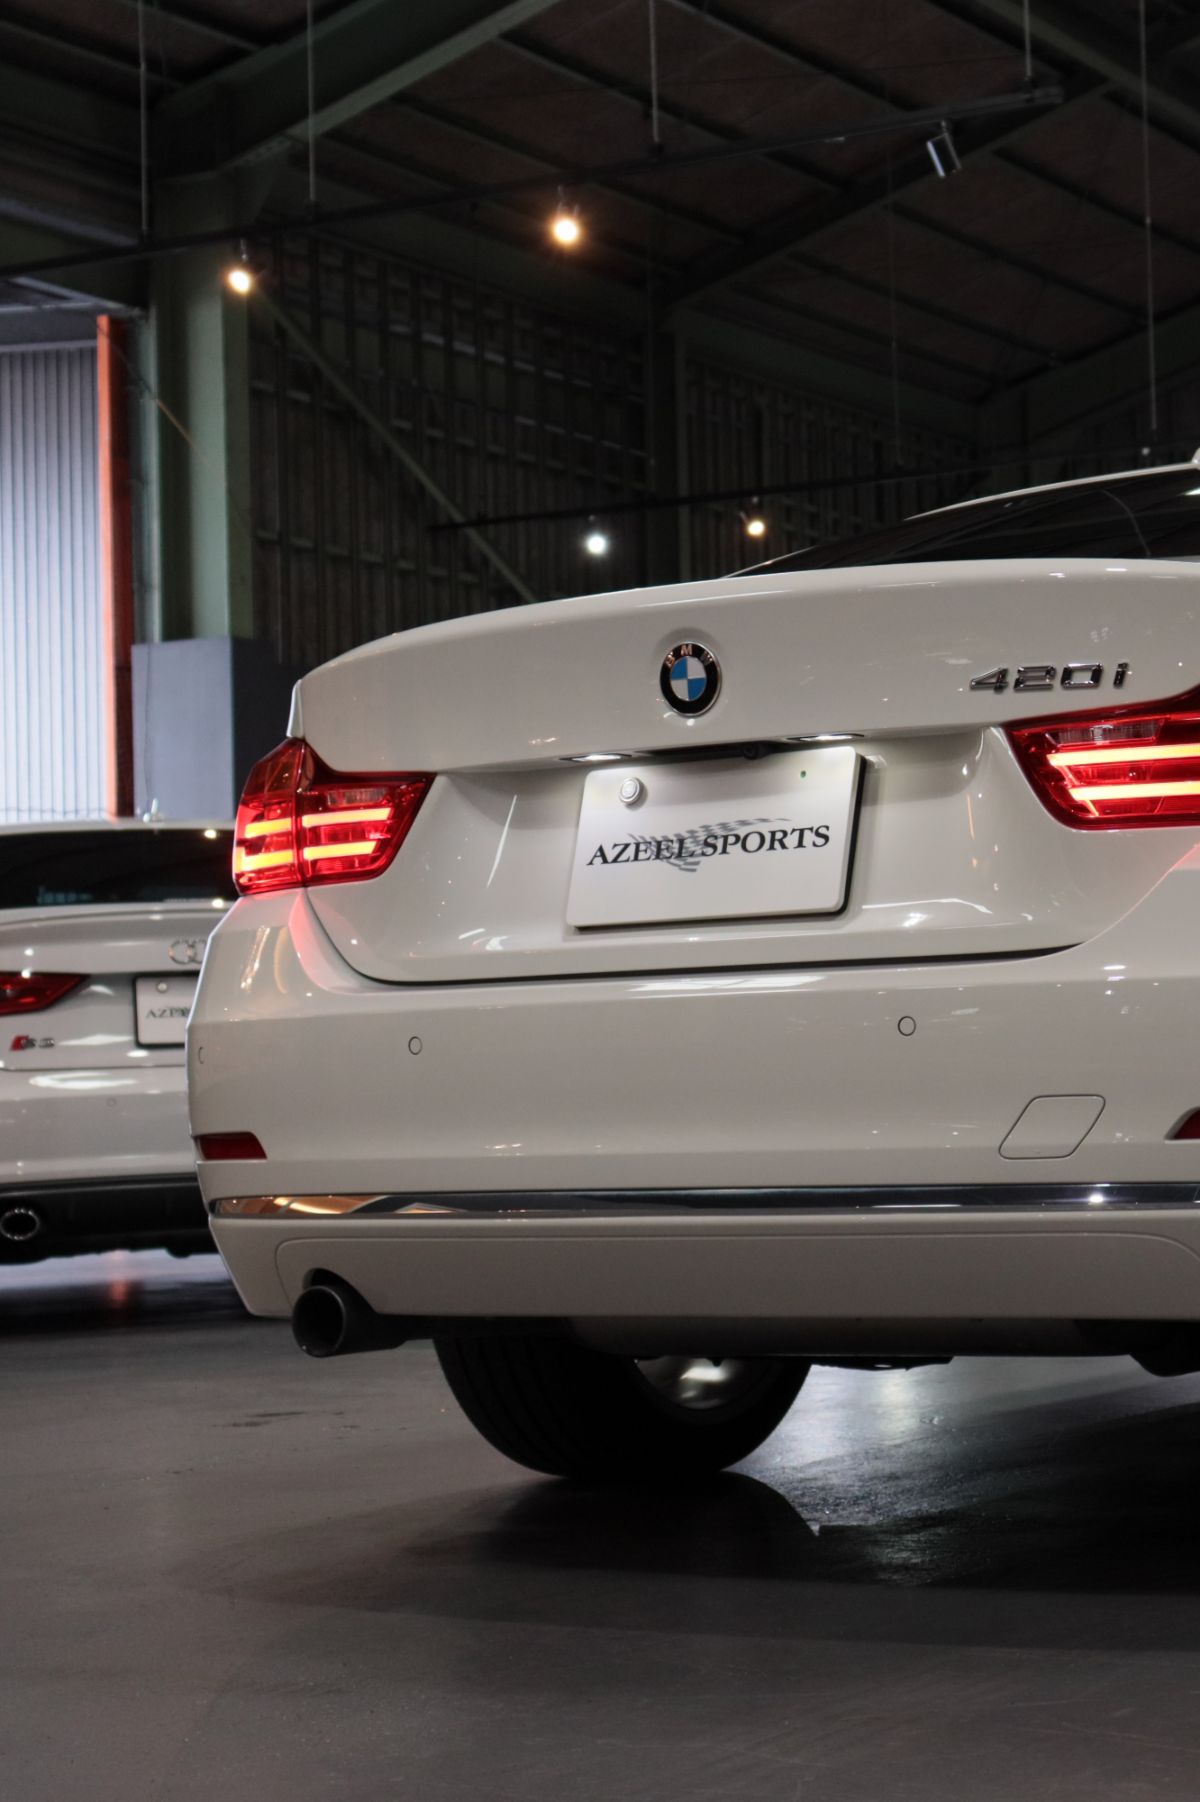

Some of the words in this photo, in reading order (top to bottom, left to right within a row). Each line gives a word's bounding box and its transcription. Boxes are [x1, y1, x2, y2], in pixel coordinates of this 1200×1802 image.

[665, 643, 713, 668] BMW
[970, 662, 1129, 694] 420i
[586, 837, 698, 866] AZEEL
[700, 824, 830, 857] SPORTS
